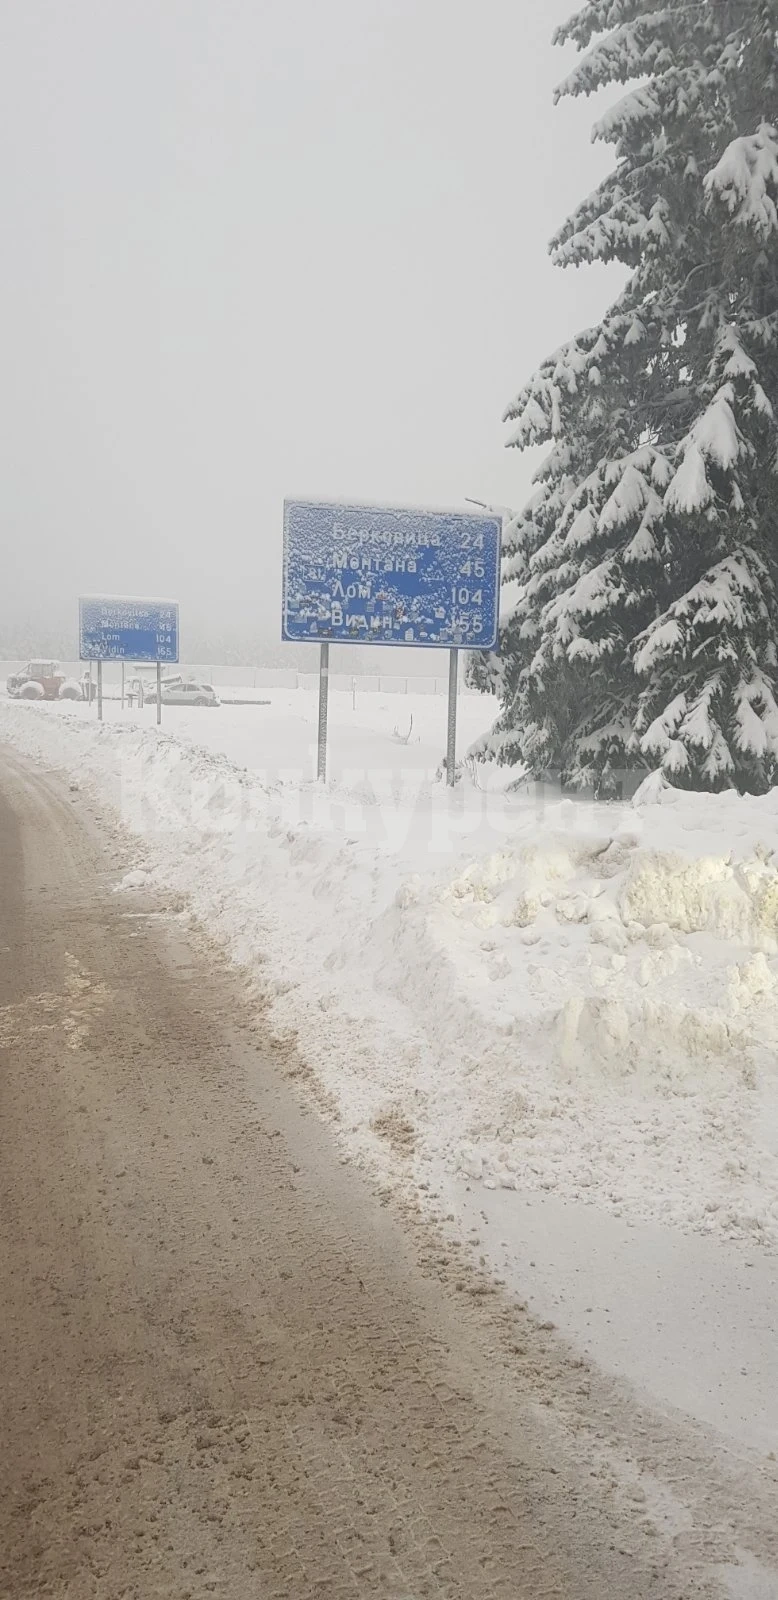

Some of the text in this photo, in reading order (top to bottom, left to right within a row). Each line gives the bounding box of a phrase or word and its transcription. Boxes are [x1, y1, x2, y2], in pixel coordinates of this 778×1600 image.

[459, 532, 484, 550] 24
[332, 554, 485, 578] Монтана 45
[332, 581, 483, 605] Лом 104
[101, 619, 140, 630] Montana
[331, 608, 483, 633] Видин 155
[102, 632, 171, 643] Lom 104
[157, 647, 171, 656] 155
